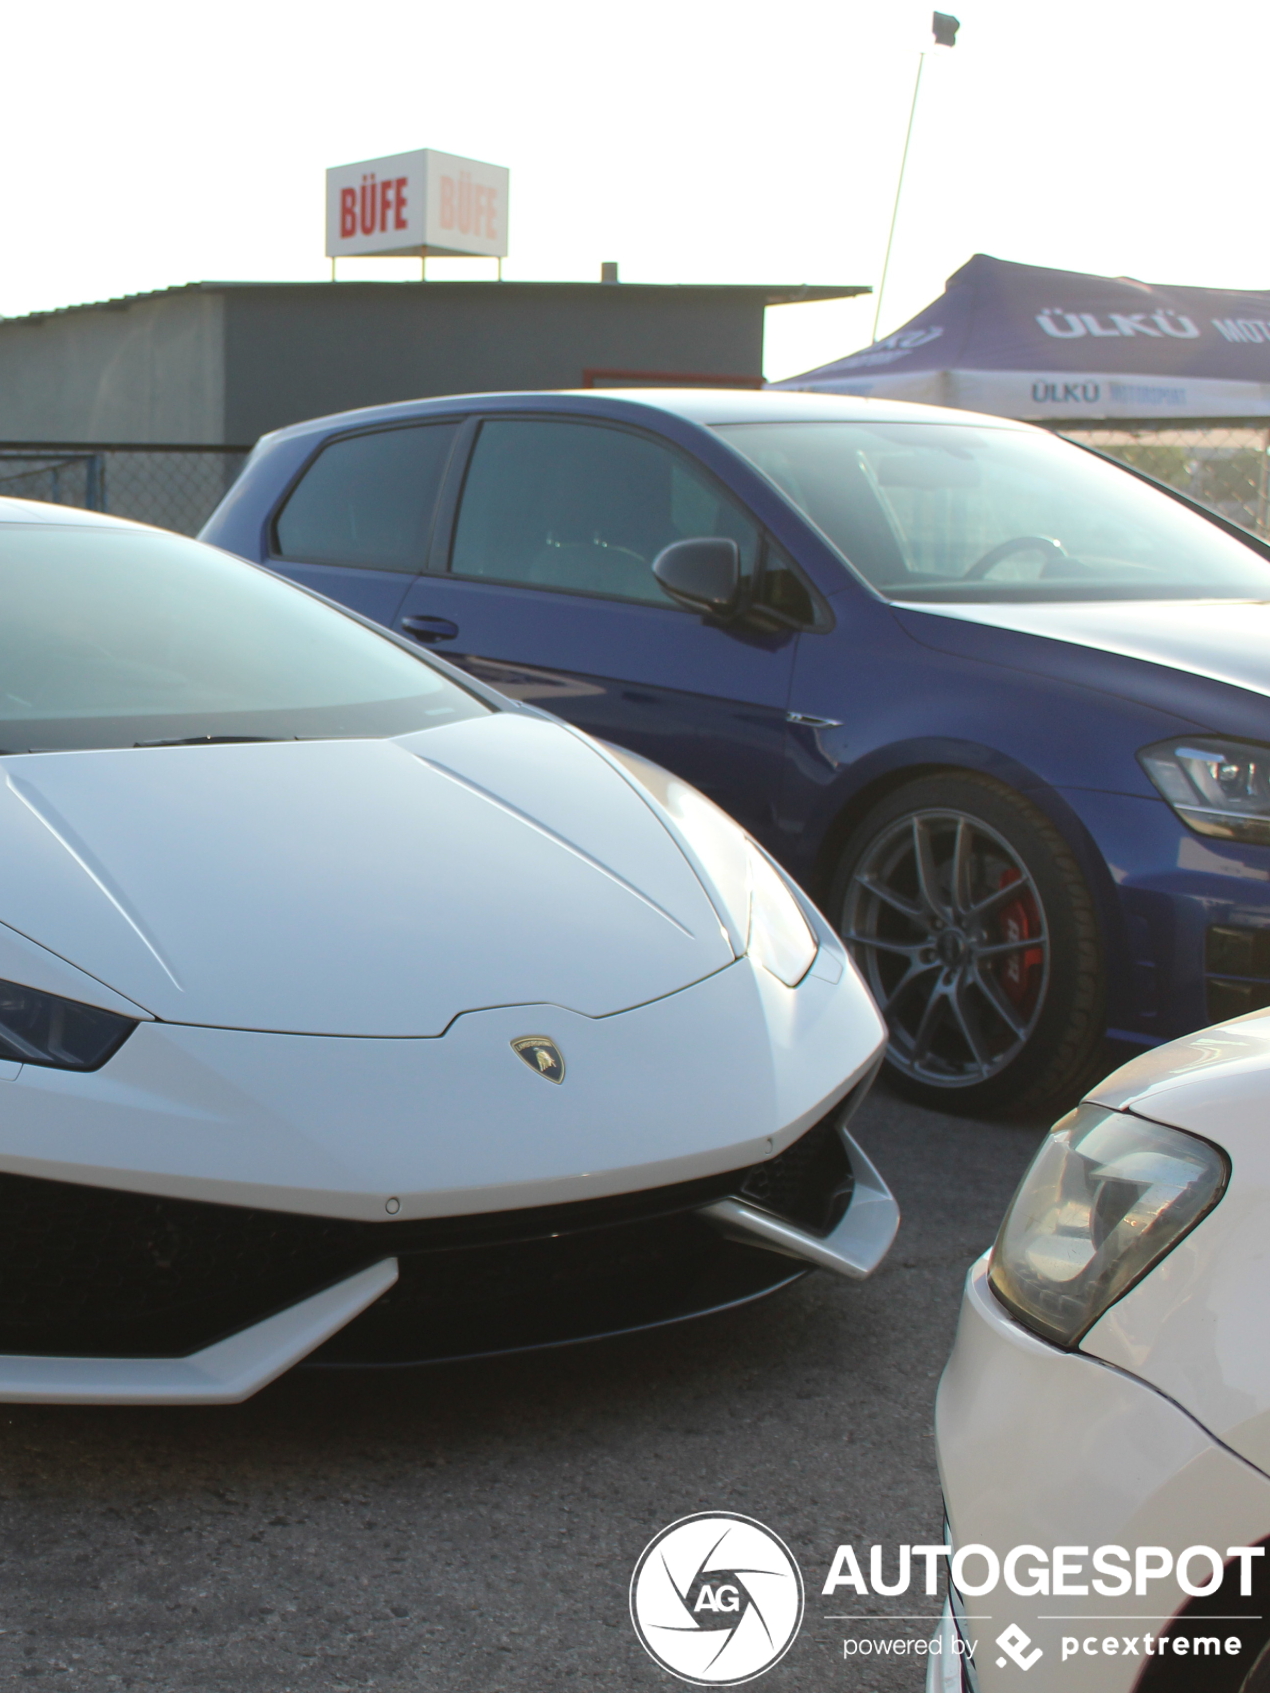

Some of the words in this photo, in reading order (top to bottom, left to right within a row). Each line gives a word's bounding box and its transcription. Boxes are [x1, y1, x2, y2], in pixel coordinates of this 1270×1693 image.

[340, 173, 408, 239] BÜFE
[439, 170, 498, 240] BÜFE
[1034, 307, 1200, 339] ÜLKÜ
[1210, 318, 1270, 343] MOT
[1032, 379, 1100, 403] ÜLKÜ
